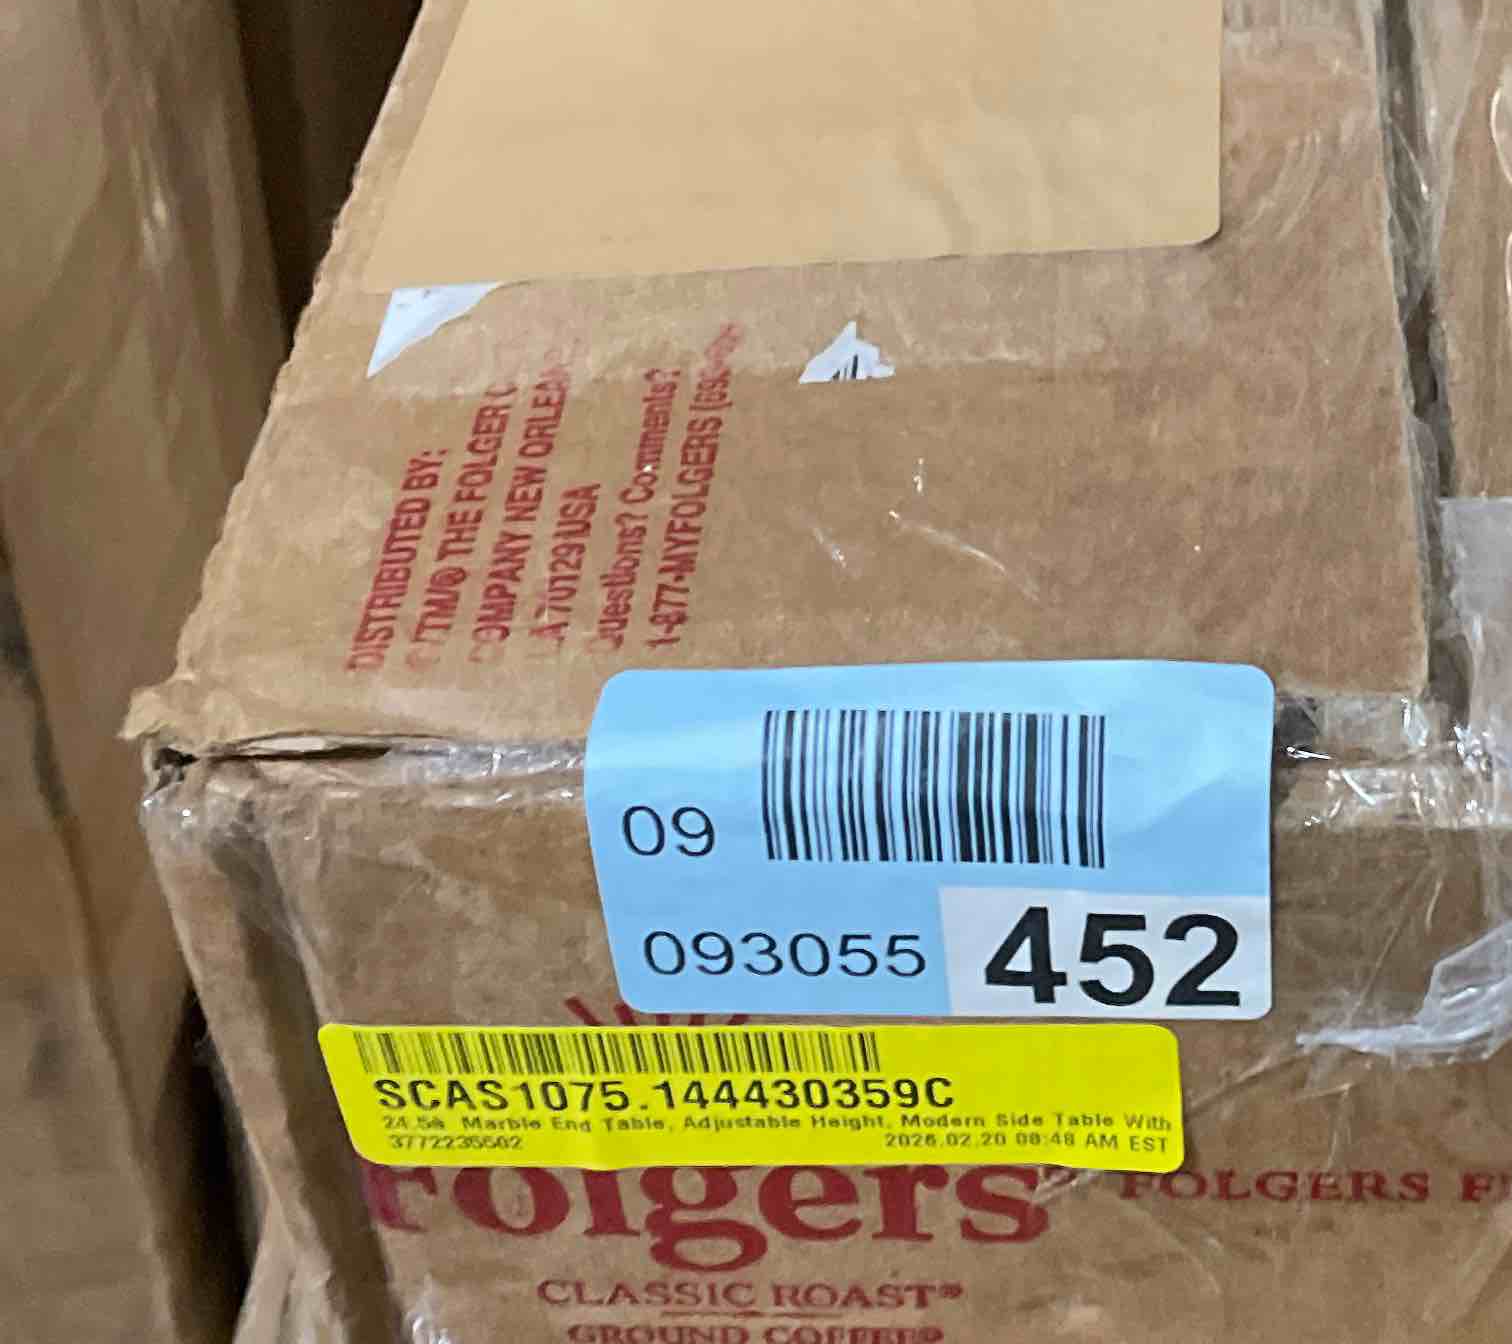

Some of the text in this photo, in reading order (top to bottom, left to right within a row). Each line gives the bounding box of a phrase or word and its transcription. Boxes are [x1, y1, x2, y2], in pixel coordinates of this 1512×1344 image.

[456, 408, 512, 499] FOLGER
[502, 467, 549, 520] NEW
[552, 484, 602, 539] USA
[345, 449, 449, 670] DISTRIBUTED BY:
[438, 511, 485, 559] THE
[622, 805, 717, 858] 09
[643, 906, 1241, 1008] 093055 452
[373, 1077, 955, 1111] SCAS1075.144430359C
[462, 1115, 540, 1131] Marble
[552, 1116, 592, 1133] End
[683, 1115, 801, 1134] Adjustable
[900, 1112, 986, 1128] Modern
[997, 1112, 1043, 1128] Side
[1056, 1112, 1114, 1128] Table
[1125, 1113, 1173, 1132] With
[1085, 1133, 1119, 1150] AM
[1130, 1136, 1170, 1154] EST
[1119, 1168, 1431, 1204] FOLGERS
[536, 1278, 757, 1307] CLASSIC
